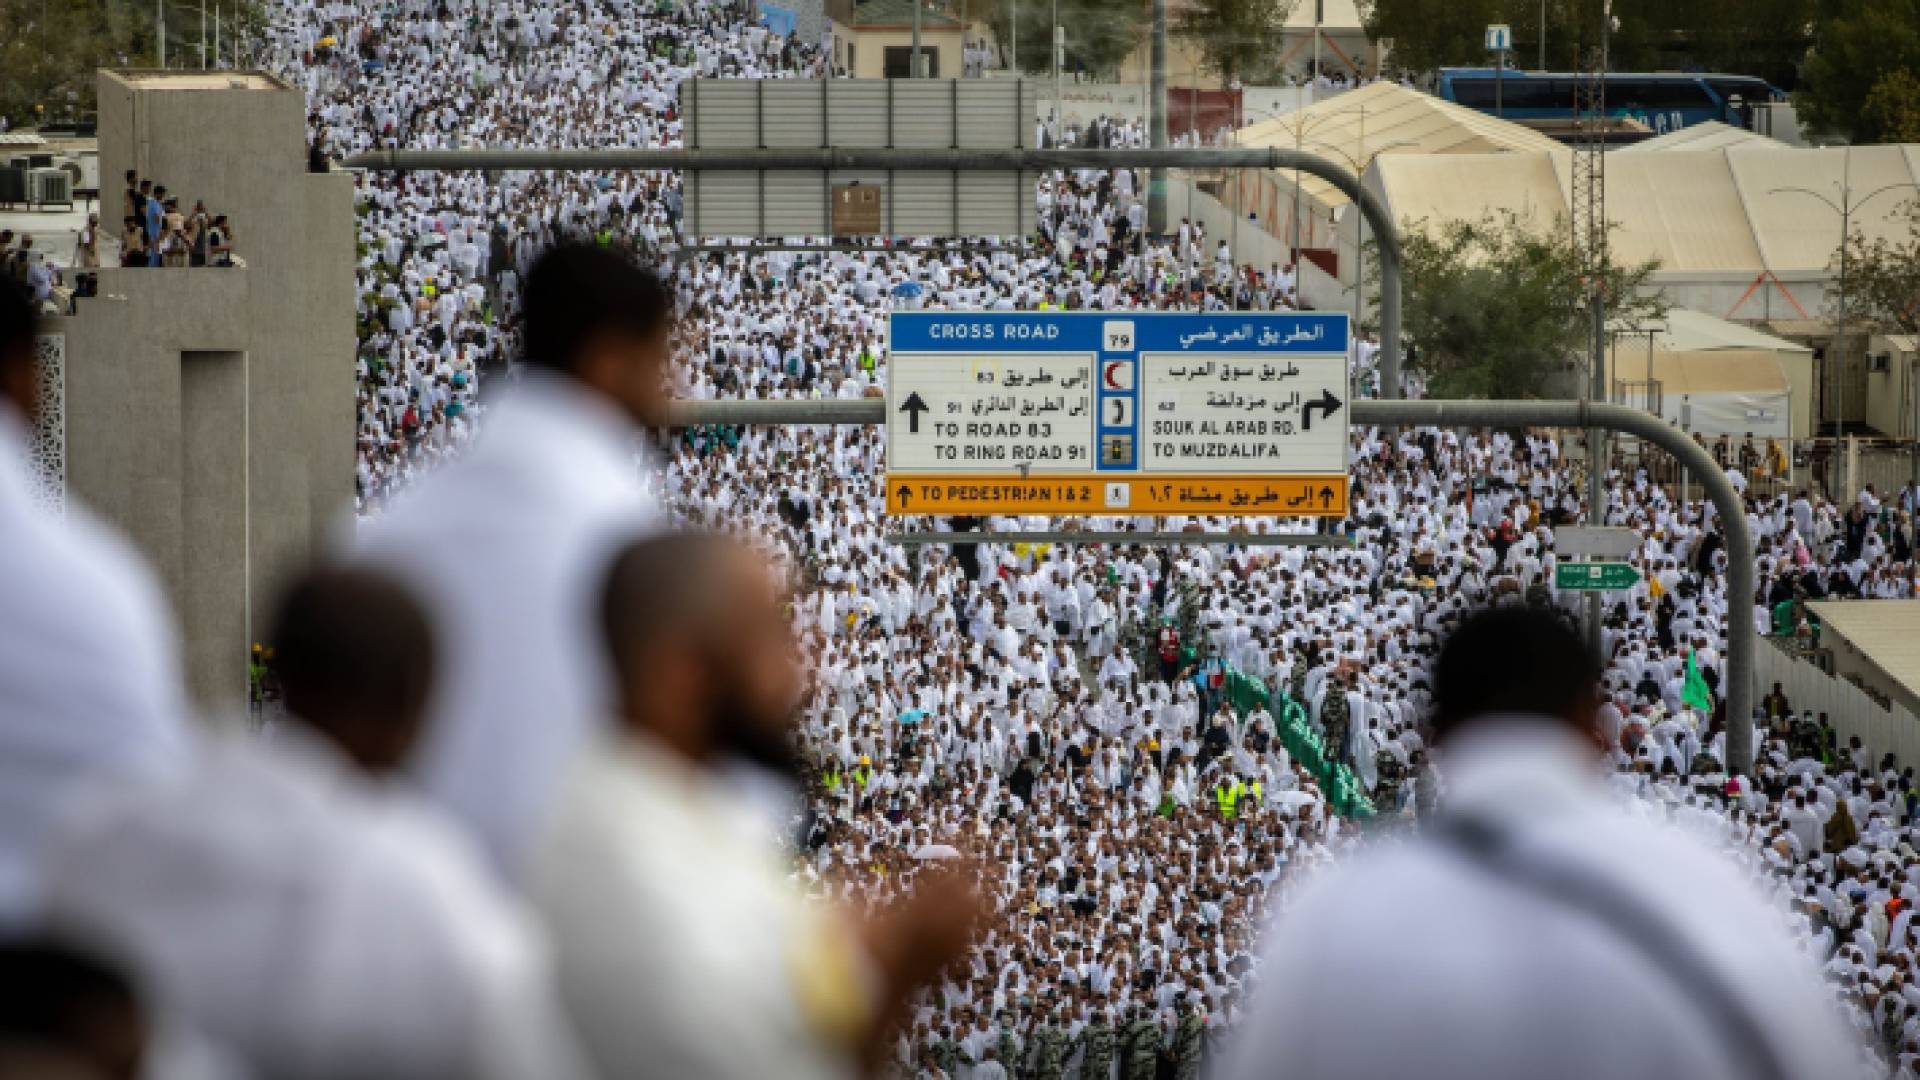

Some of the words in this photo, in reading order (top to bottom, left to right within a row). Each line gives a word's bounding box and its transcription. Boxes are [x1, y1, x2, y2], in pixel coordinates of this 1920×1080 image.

[929, 323, 995, 339] CROSS
[1003, 323, 1060, 339] ROAD
[1109, 334, 1130, 347] 79
[1180, 323, 1254, 349] العرضي
[1258, 323, 1324, 346] الطريق
[1001, 366, 1054, 387] طريق
[1061, 366, 1089, 389] إلى
[1169, 361, 1216, 382] العرب
[1220, 363, 1254, 382] سوق
[1258, 361, 1300, 382] طريق
[972, 396, 1016, 417] الدائري
[1020, 396, 1065, 417] الطريق
[1069, 396, 1089, 417] إلى
[1206, 390, 1267, 411] مزدلفة
[1273, 390, 1300, 414] إلى
[934, 422, 959, 438] TO
[966, 422, 1022, 438] ROAD
[1028, 422, 1052, 438] 83
[1152, 420, 1195, 435] SOUK
[1201, 420, 1220, 435] AL
[1225, 420, 1268, 435] ARAB
[1271, 420, 1297, 435] RD.
[934, 444, 958, 460] TO
[963, 444, 1006, 460] RING
[1012, 444, 1062, 460] ROAD
[1068, 444, 1087, 460] 91
[1152, 442, 1175, 457] TO
[1180, 442, 1281, 457] MUZDALIFA
[921, 485, 942, 500] TO
[947, 485, 1051, 501] PEDESTRIAN
[1179, 486, 1223, 502] مشاة
[1229, 485, 1279, 506] طريق
[1286, 485, 1314, 508] إلى
